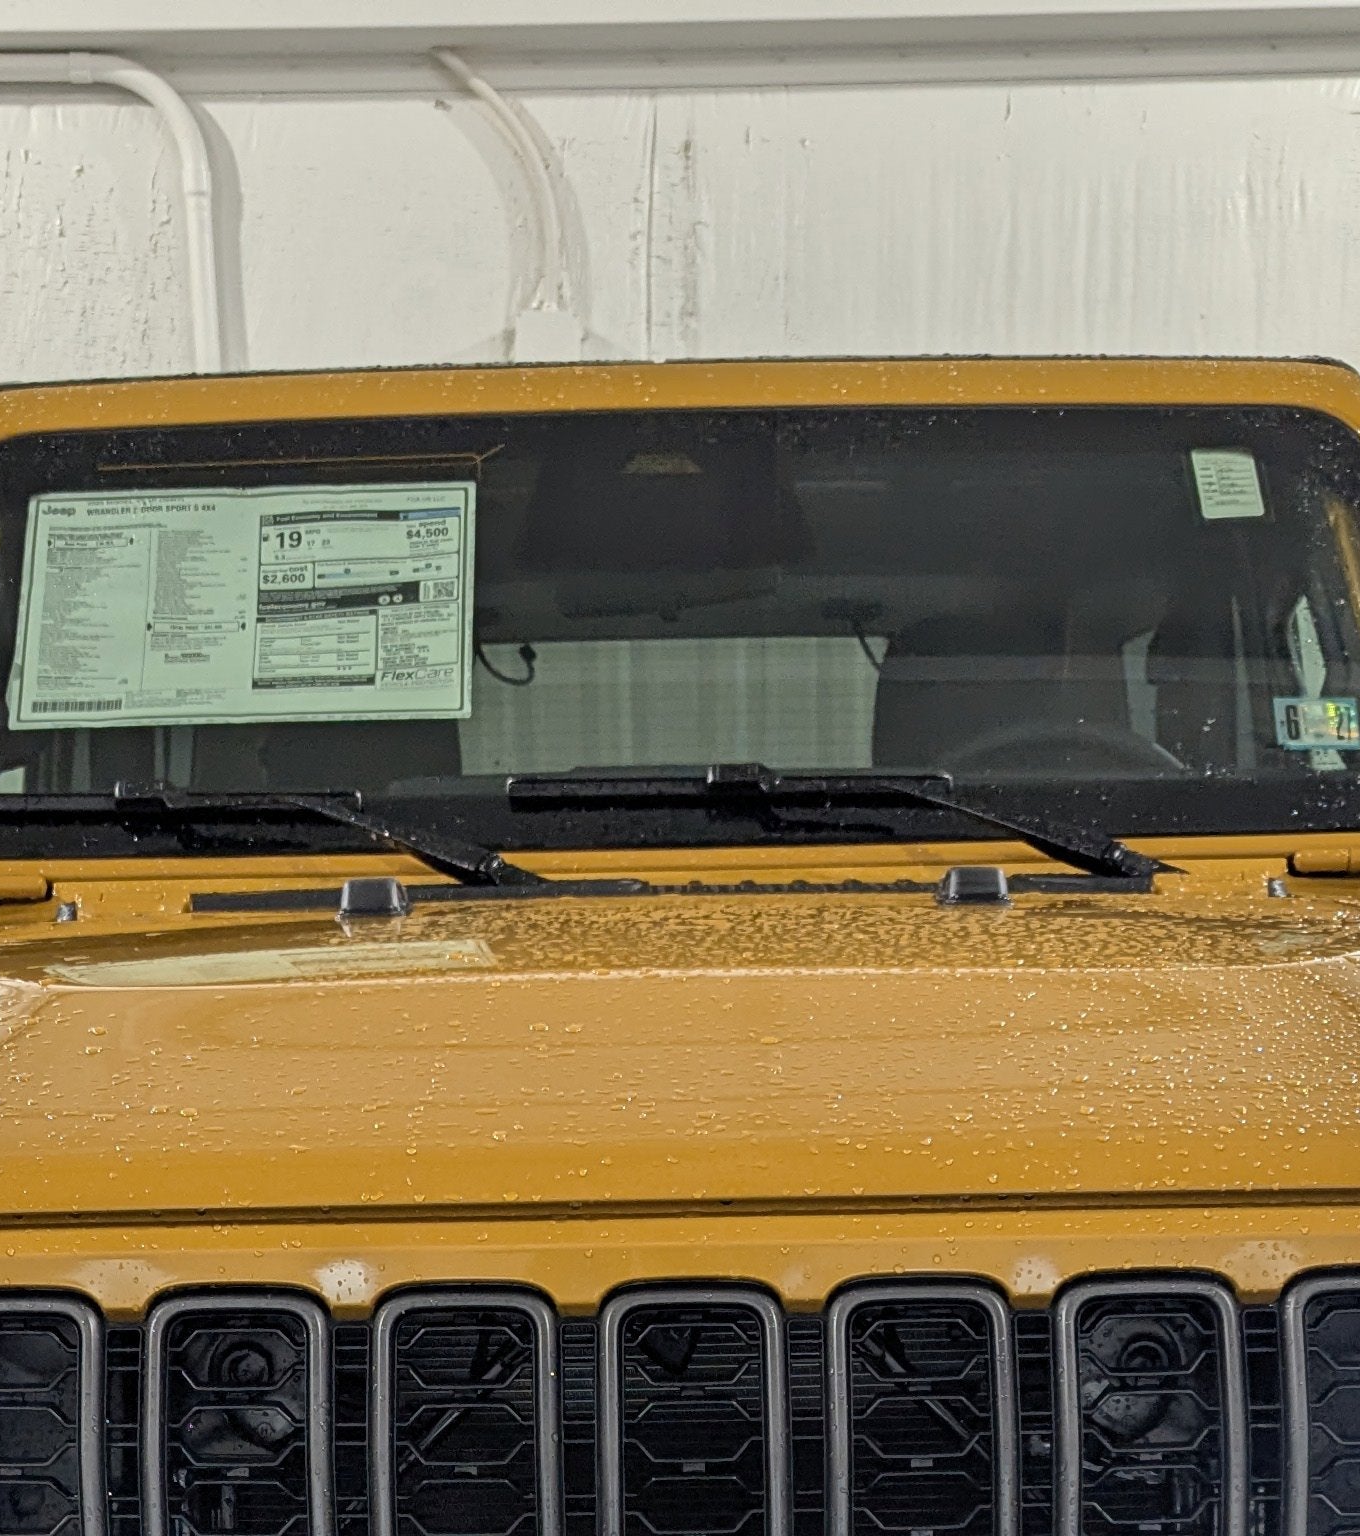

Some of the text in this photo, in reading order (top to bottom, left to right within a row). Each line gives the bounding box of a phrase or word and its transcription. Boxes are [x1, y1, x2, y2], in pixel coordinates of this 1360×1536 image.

[42, 505, 76, 517] Jeep
[165, 504, 192, 513] SPORT
[406, 527, 449, 540] $4,500
[275, 531, 303, 549] 19
[289, 565, 309, 573] cost
[262, 573, 306, 585] $2,600
[381, 668, 454, 682] FlexCare
[1285, 704, 1301, 740] 6
